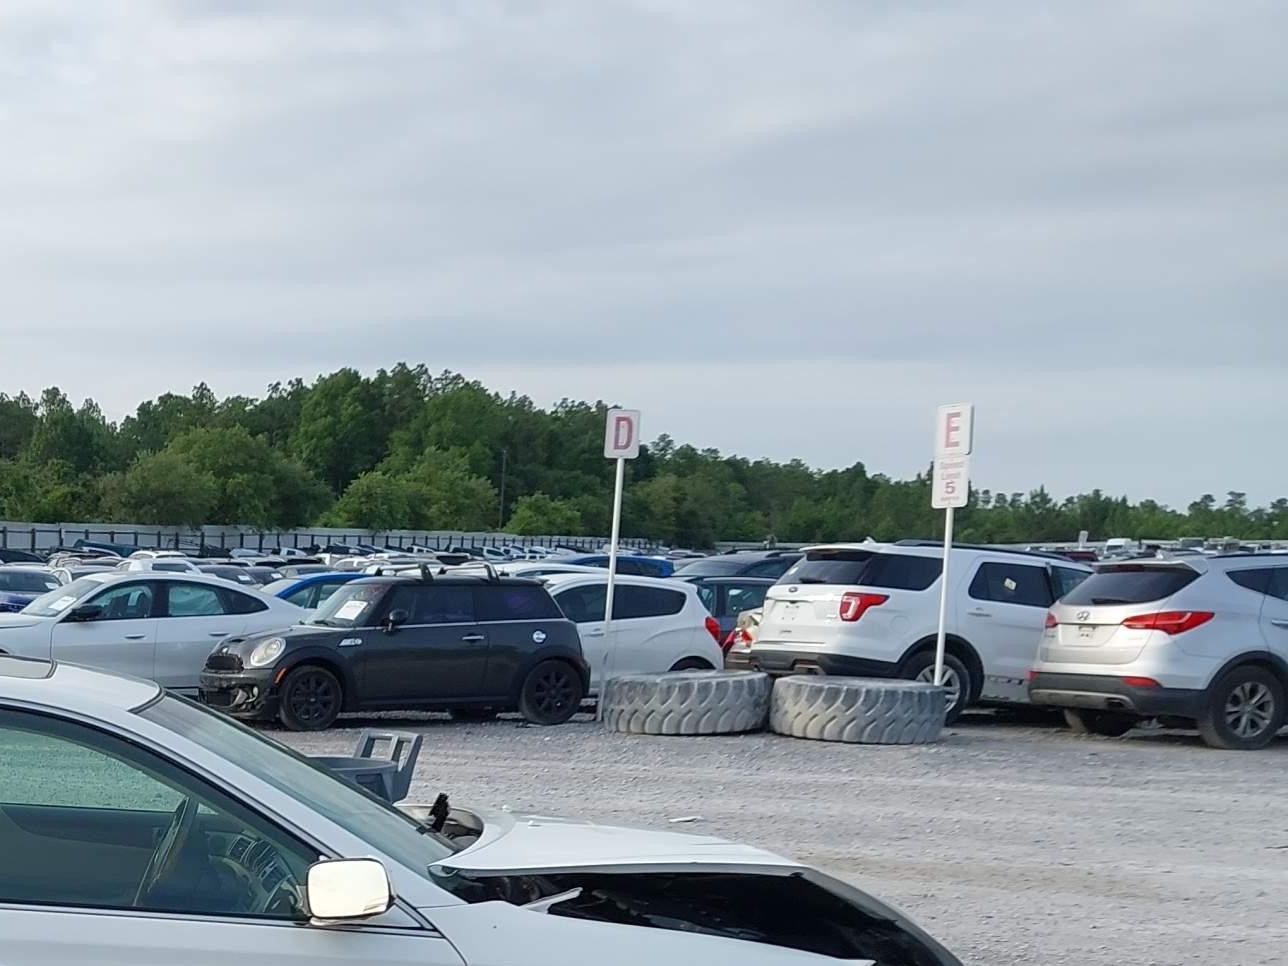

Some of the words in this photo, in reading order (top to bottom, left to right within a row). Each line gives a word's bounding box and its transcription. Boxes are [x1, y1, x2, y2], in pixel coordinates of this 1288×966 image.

[614, 416, 633, 450] D
[944, 412, 961, 448] E
[945, 481, 956, 494] 5
